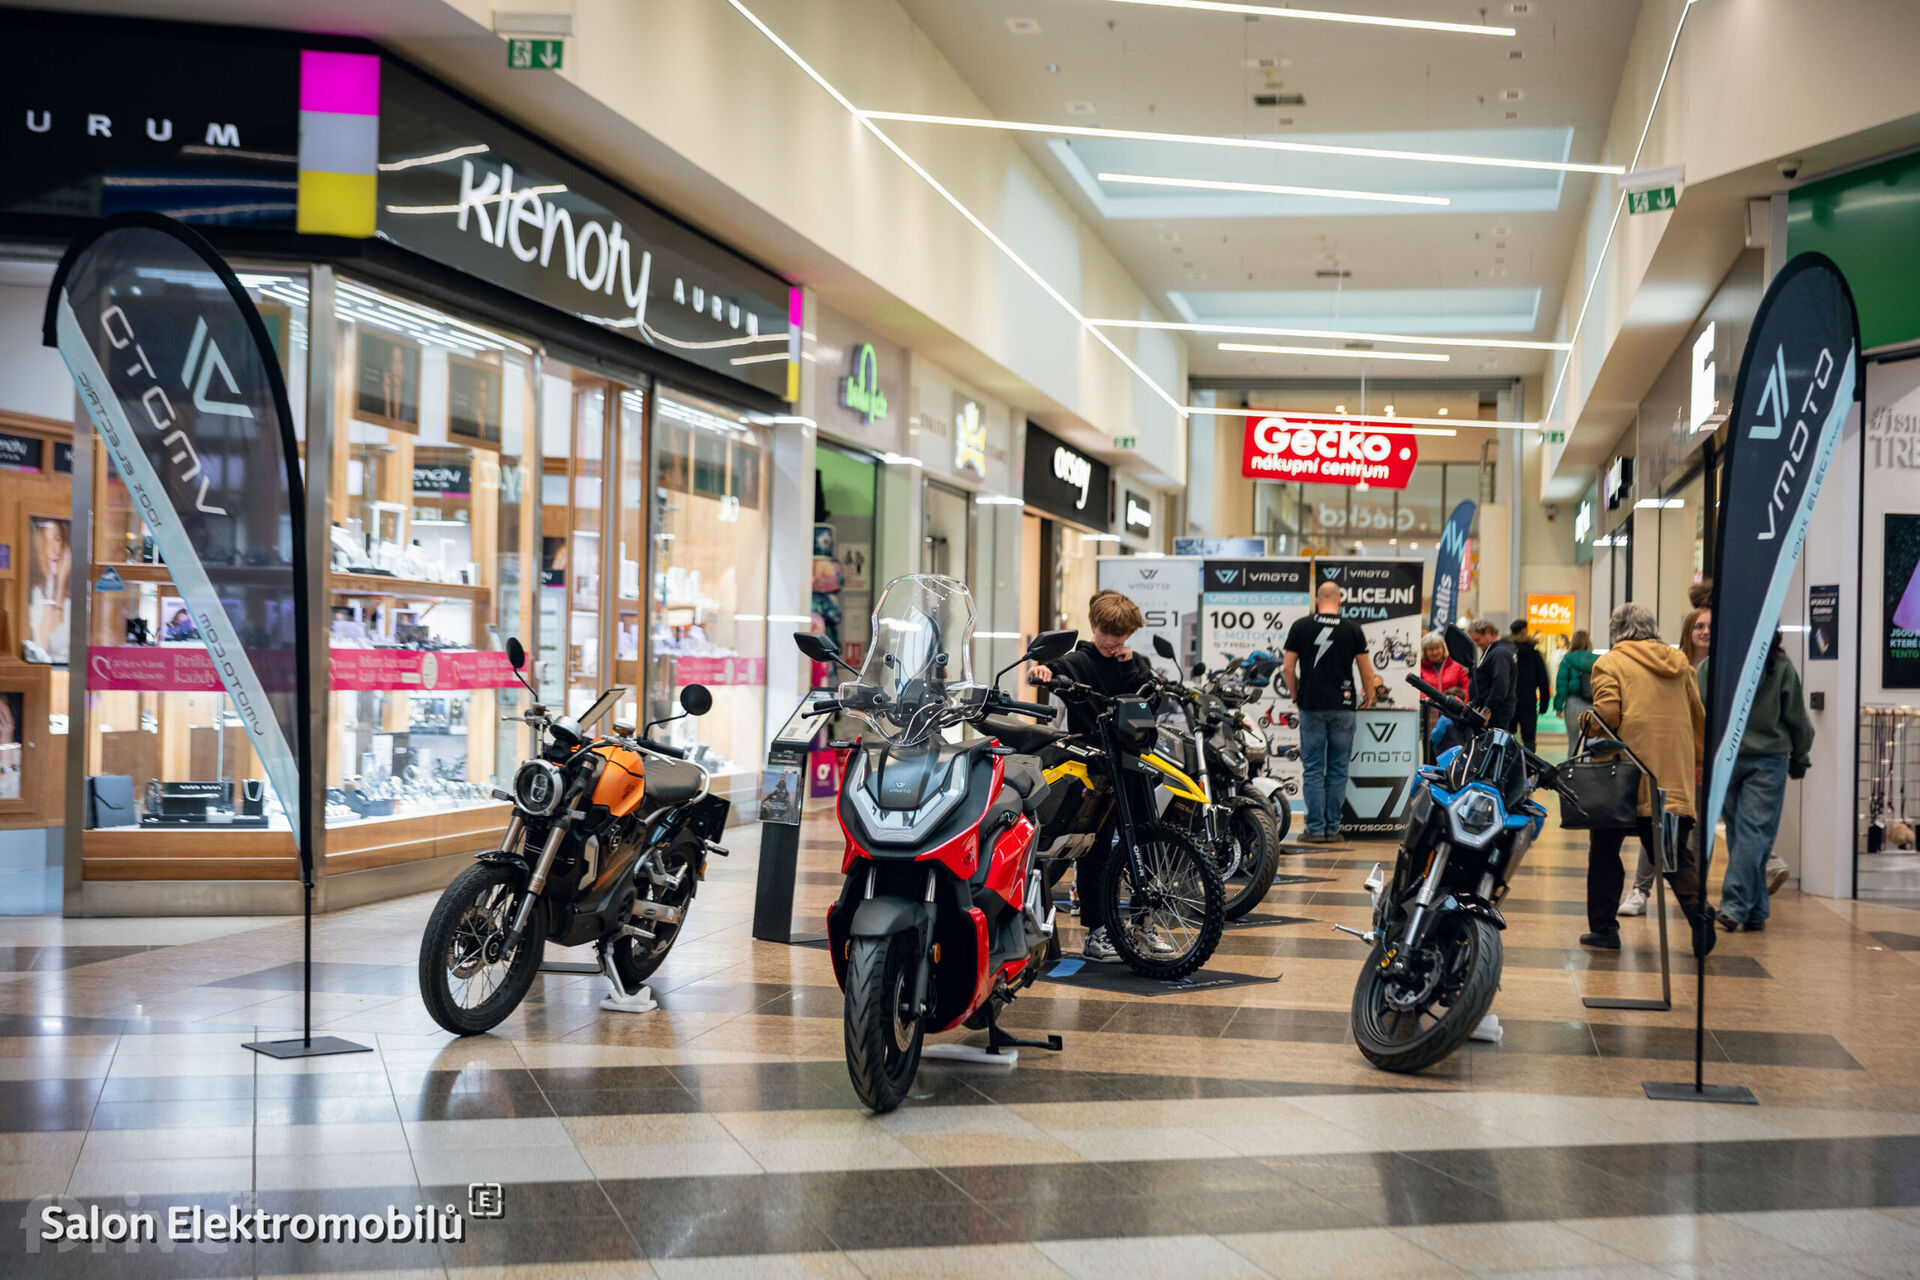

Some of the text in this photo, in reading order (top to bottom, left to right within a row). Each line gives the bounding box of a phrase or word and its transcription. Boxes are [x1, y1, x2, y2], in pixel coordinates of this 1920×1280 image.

[1251, 454, 1389, 479] nákupní centrum
[1249, 572, 1300, 583] VMOTO
[1210, 611, 1283, 630] 100 %
[1338, 606, 1389, 619] LOTILA
